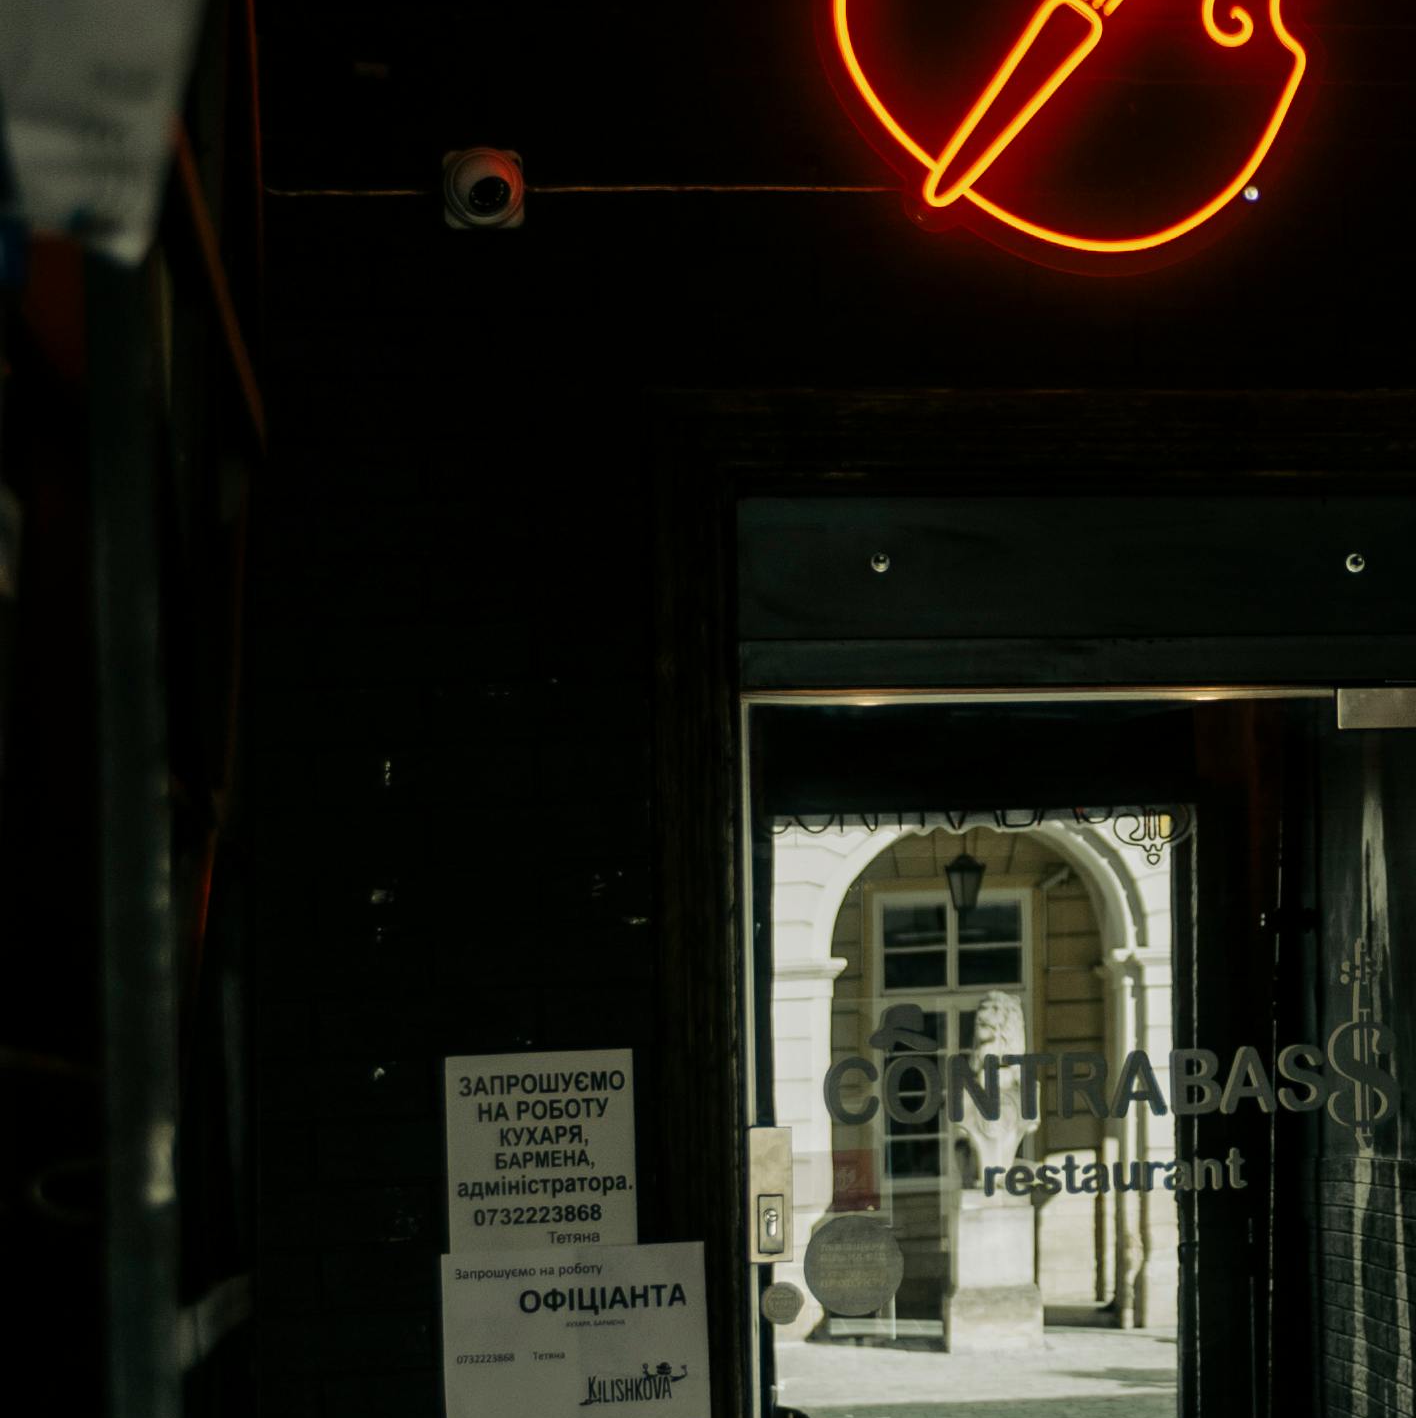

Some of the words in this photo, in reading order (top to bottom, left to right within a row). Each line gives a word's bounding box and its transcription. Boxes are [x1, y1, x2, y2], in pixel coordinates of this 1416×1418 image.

[458, 1069, 626, 1097] ЗАПРОШУЄМО
[477, 1102, 510, 1123] НА
[516, 1097, 609, 1122] РОБОТУ
[499, 1124, 590, 1148] КУХАРЯ,
[494, 1148, 596, 1171] БАРМЕНА,
[982, 1147, 1248, 1197] restaurant
[456, 1173, 634, 1201] адміністратора.
[473, 1204, 603, 1227] 0732223868
[547, 1230, 600, 1245] Тетяна
[454, 1264, 537, 1282] Запрошуємо
[539, 1266, 555, 1277] на
[557, 1263, 604, 1280] роботу
[518, 1282, 687, 1316] ОФІЦІАНТА
[532, 1350, 566, 1362] Тетяна
